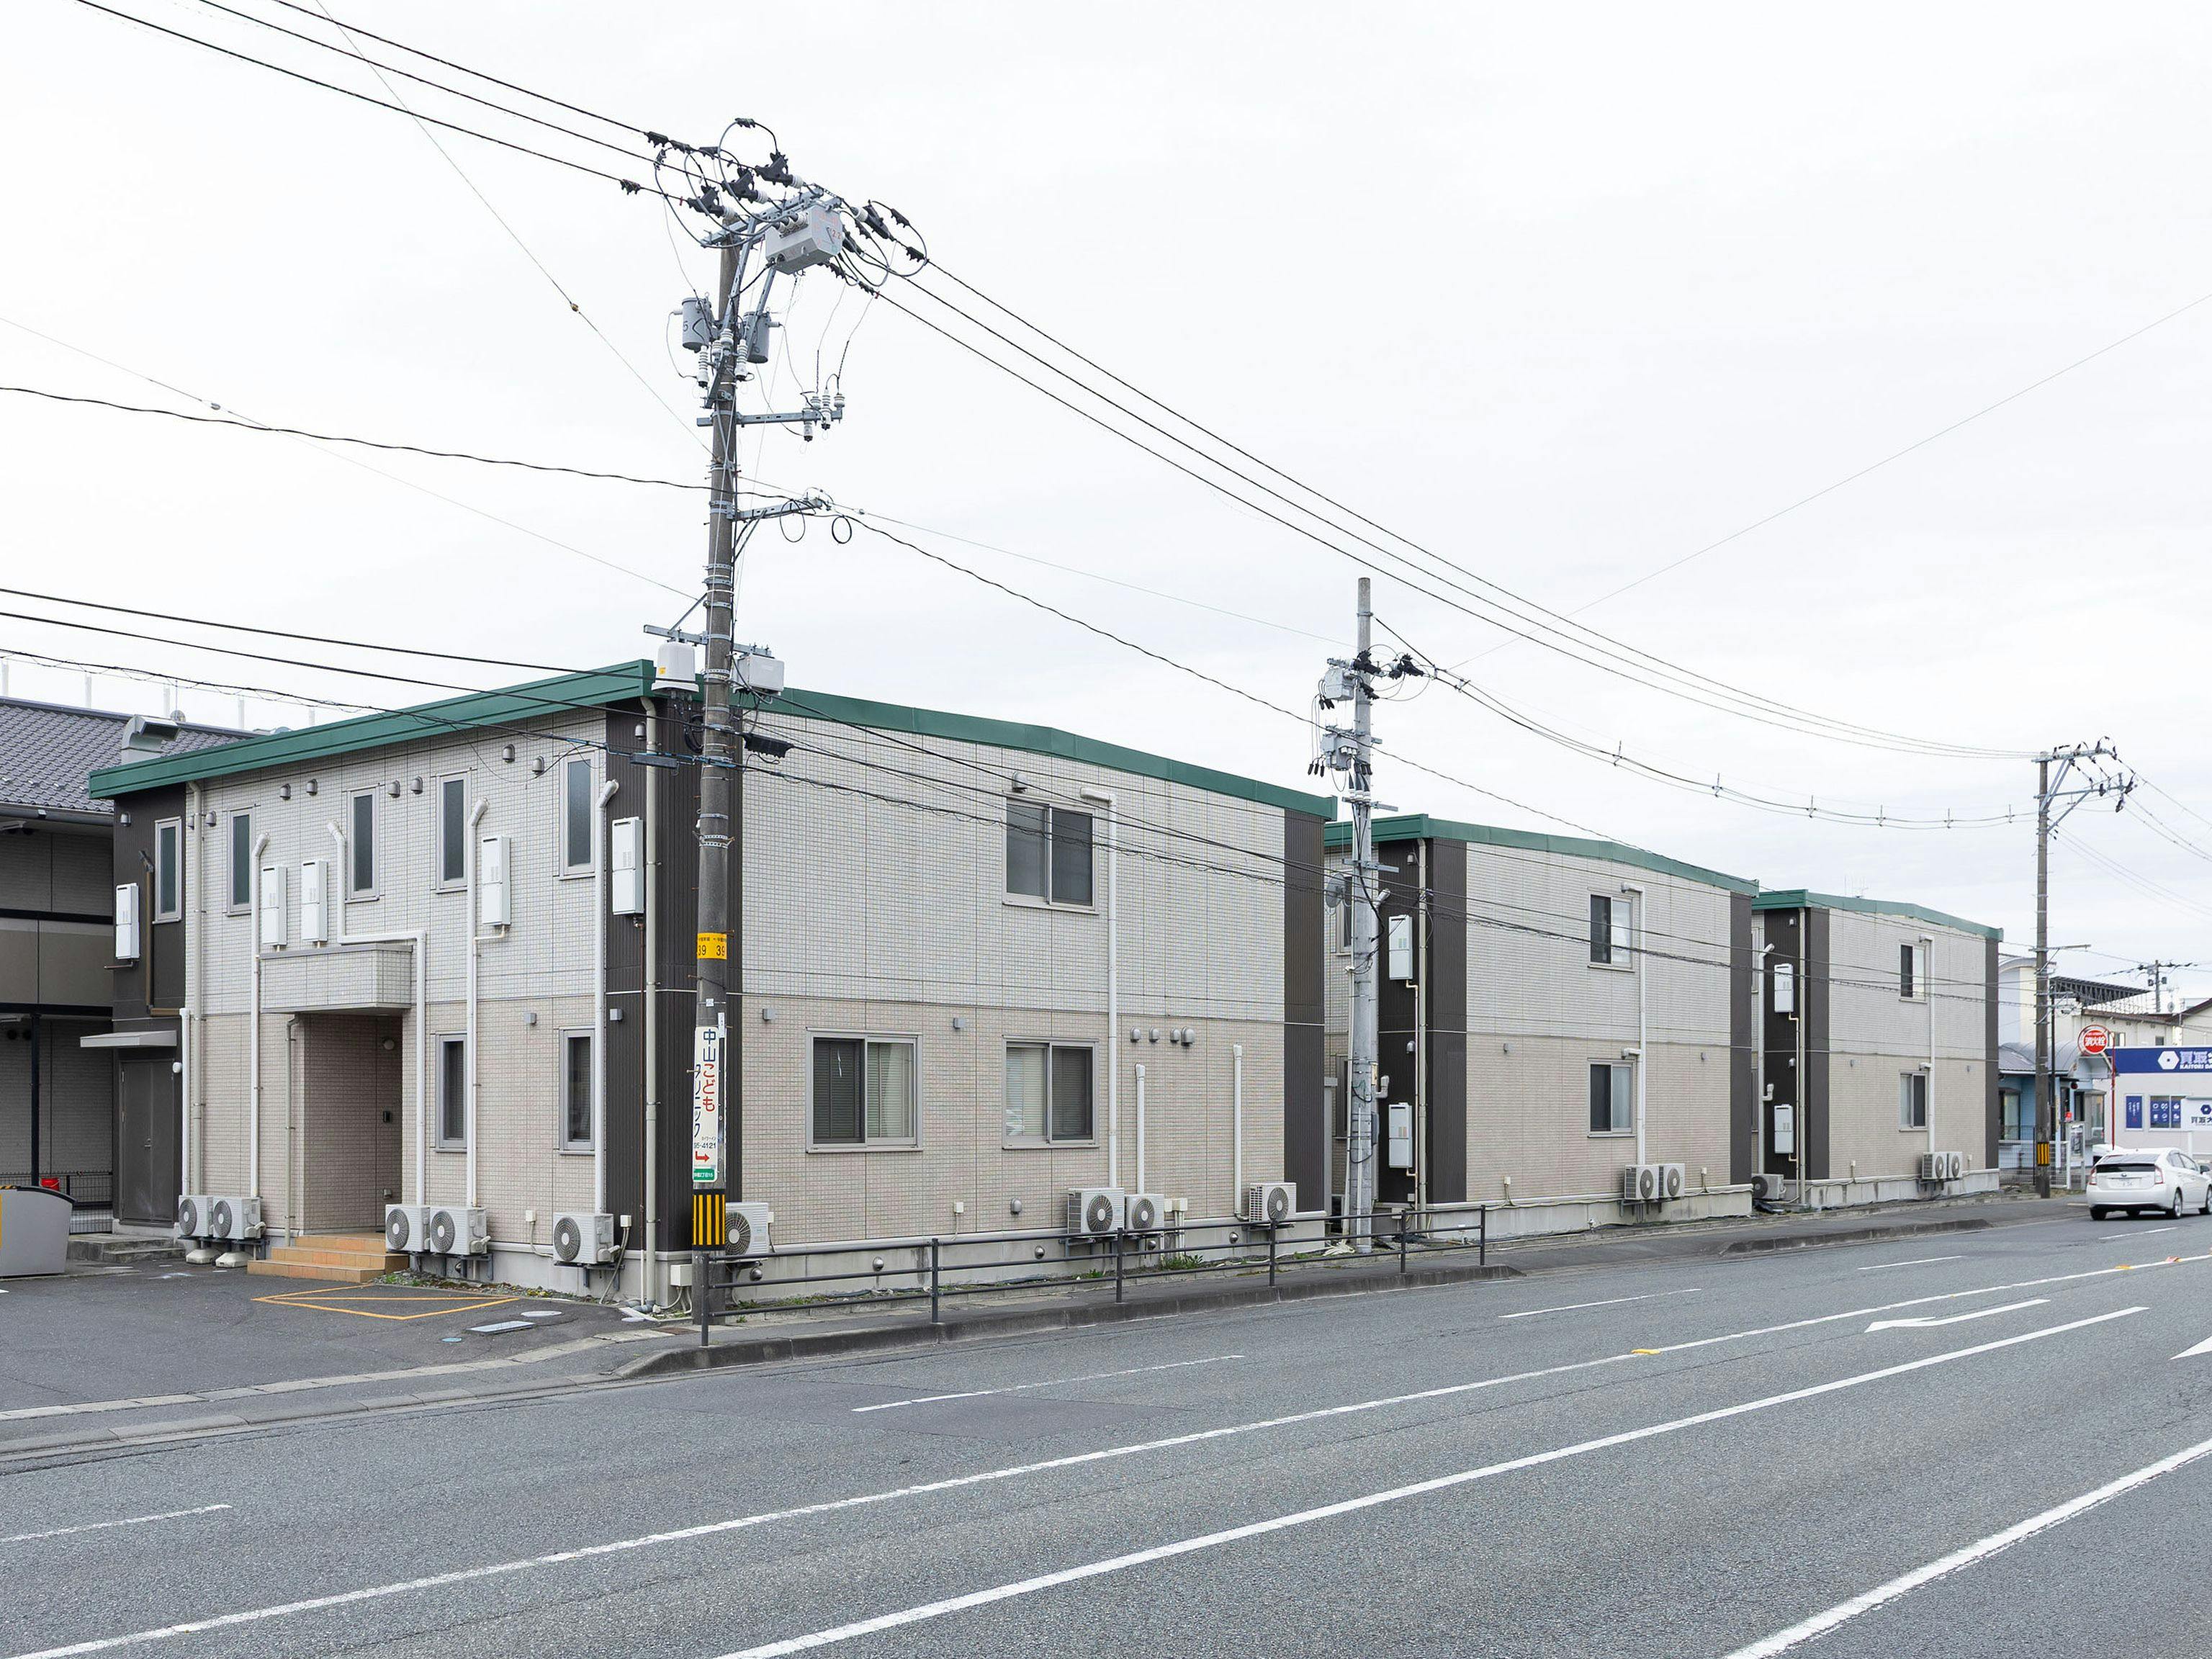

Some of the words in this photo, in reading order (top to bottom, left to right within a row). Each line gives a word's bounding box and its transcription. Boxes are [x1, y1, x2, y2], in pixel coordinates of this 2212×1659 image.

[716, 945, 725, 956] 39
[2085, 1035, 2105, 1046] 消火栓
[703, 1028, 716, 1112] 中山こども
